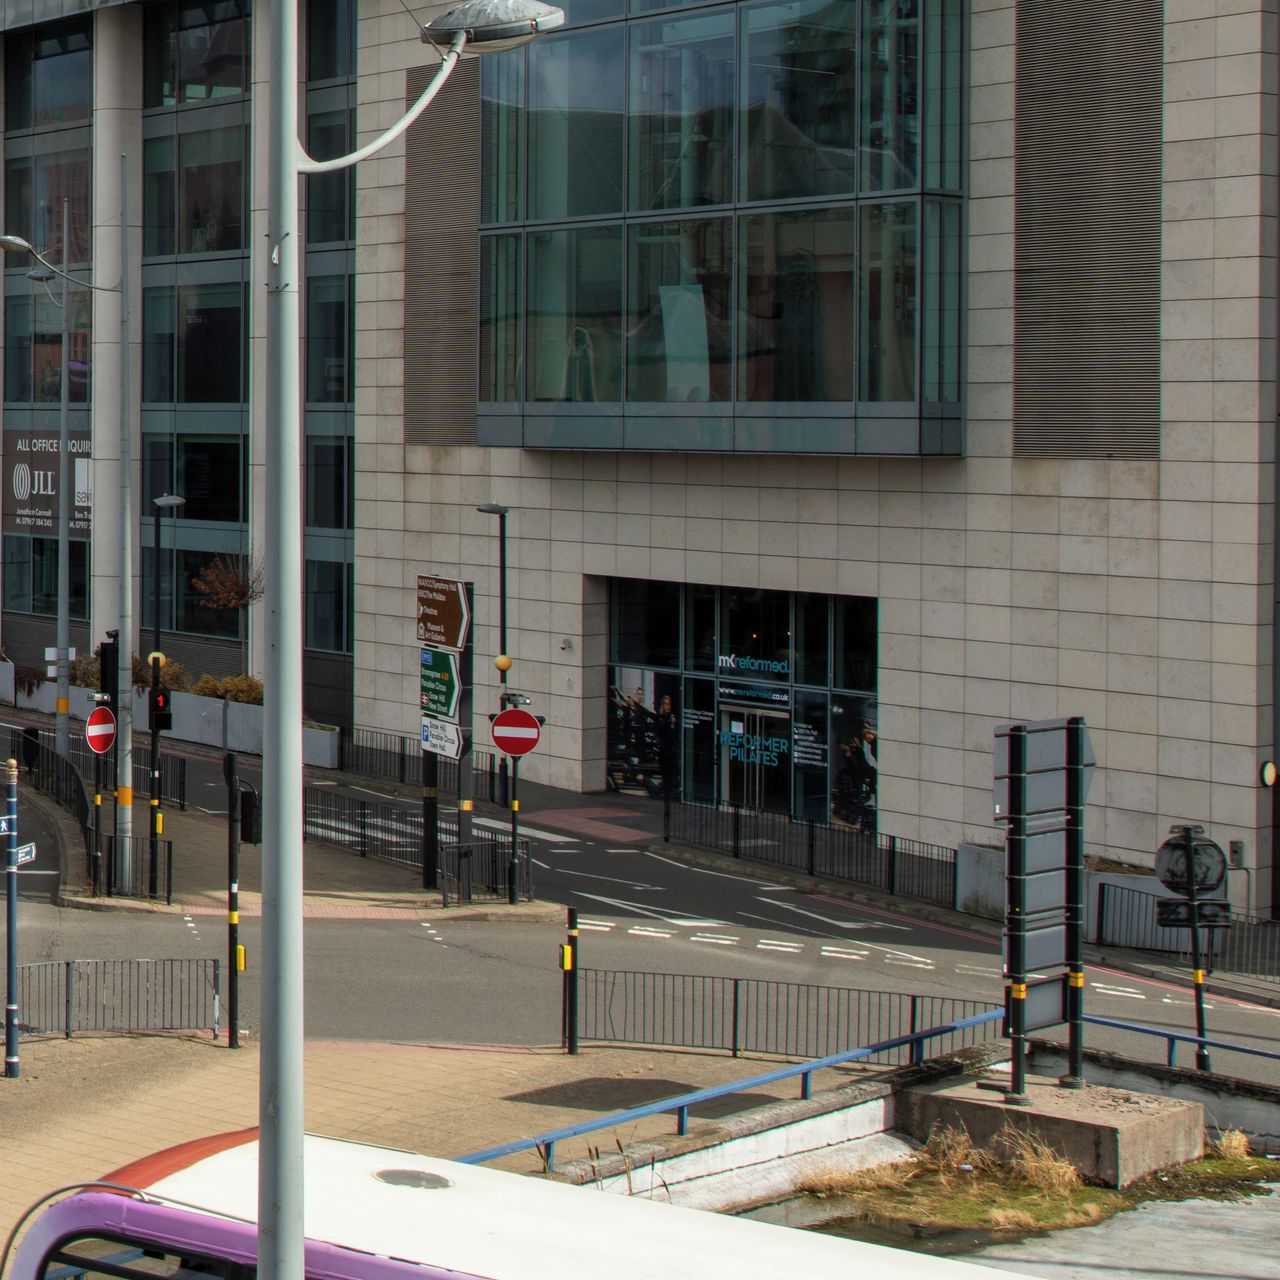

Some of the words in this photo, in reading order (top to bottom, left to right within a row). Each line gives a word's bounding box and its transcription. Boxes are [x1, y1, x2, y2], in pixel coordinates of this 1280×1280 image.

[16, 438, 30, 451] ALL
[32, 438, 58, 452] OFFICE
[31, 470, 56, 495] JLL
[720, 731, 788, 753] REFORMER
[729, 746, 779, 767] PILATES
